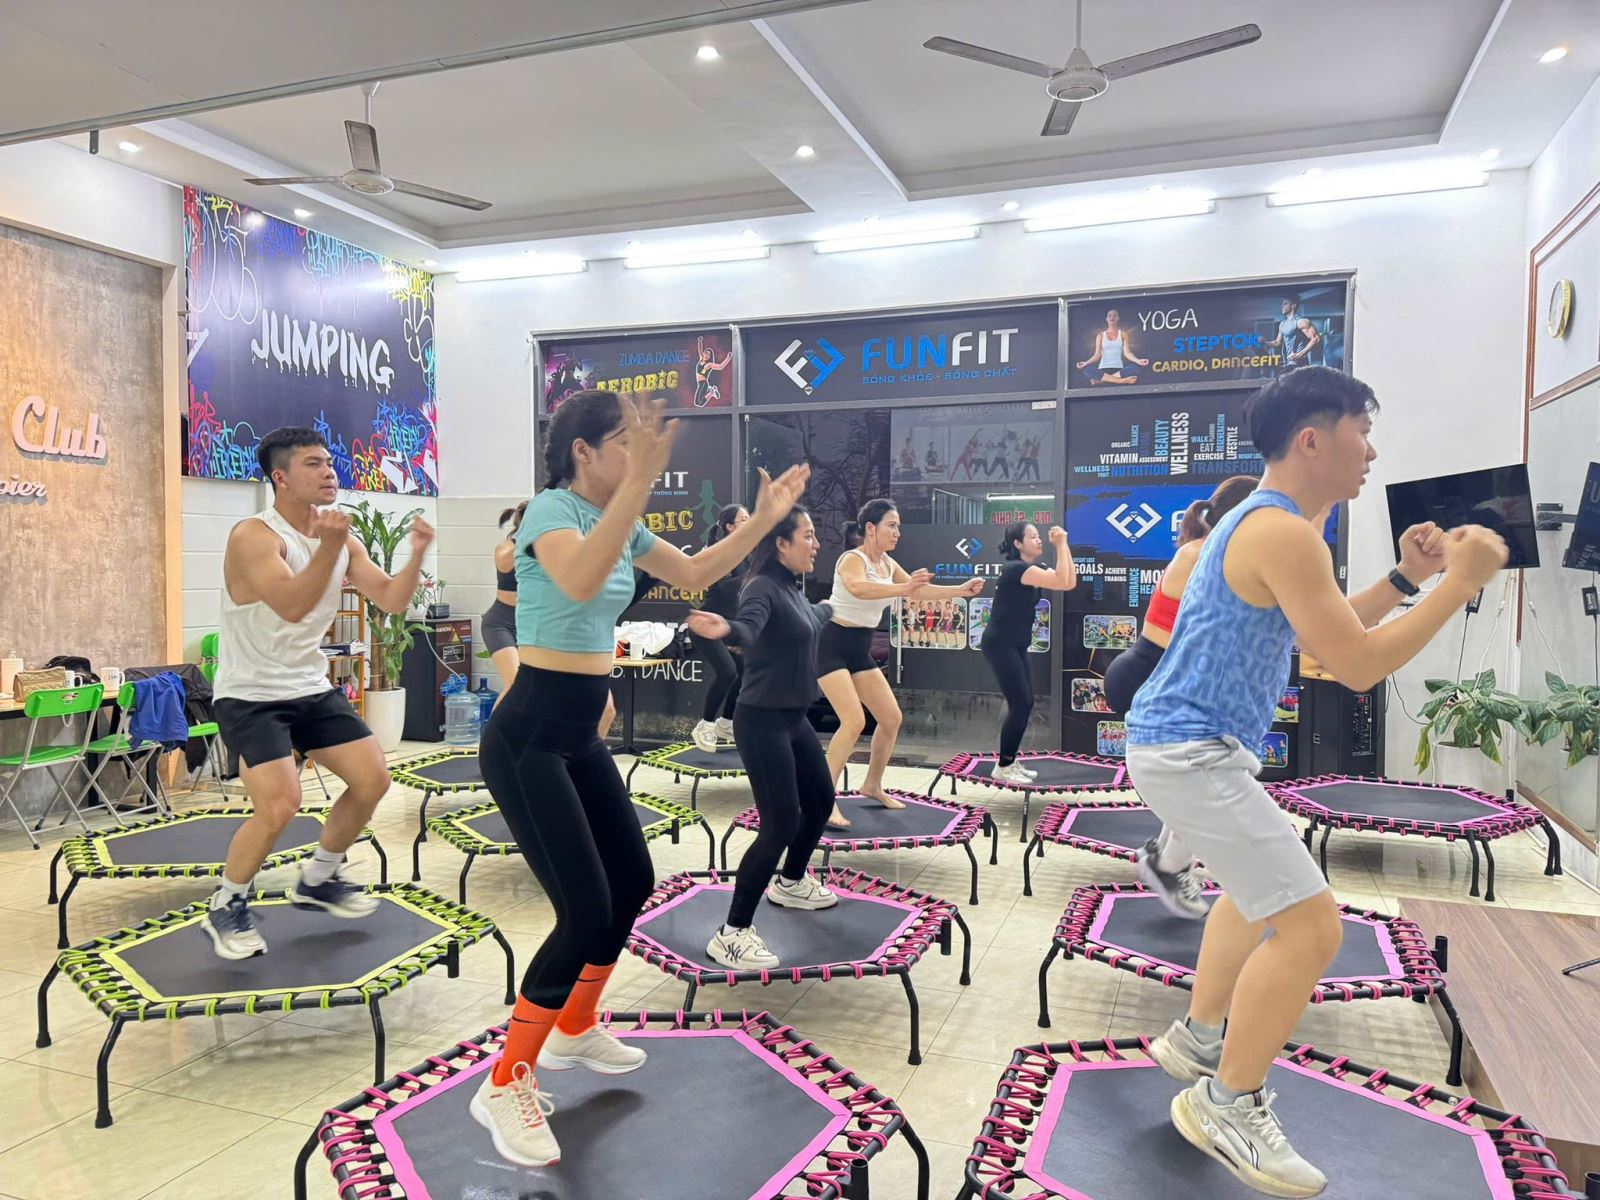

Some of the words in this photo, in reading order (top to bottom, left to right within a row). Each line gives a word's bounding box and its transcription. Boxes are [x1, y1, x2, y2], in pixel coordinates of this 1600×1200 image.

[1138, 308, 1198, 331] YOGA
[251, 308, 395, 393] JUMPING
[861, 328, 1019, 372] FUNFIT
[1152, 358, 1208, 373] CARDIO,
[1213, 354, 1281, 370] DANCEFIT
[12, 395, 107, 458] Club
[1155, 419, 1169, 456] BEAUTY
[1170, 412, 1189, 476] WELLNESS
[1191, 435, 1208, 443] WALK
[1226, 426, 1238, 460] LIFESTYLE
[1200, 443, 1215, 452] EAT
[1100, 453, 1138, 464] VITAMIN
[1194, 452, 1224, 461] EXERCISE
[1074, 465, 1110, 473] WELLNESS
[1111, 464, 1168, 477] NUTRITION
[650, 472, 689, 488] FIT
[935, 563, 1004, 576] FUNFIT
[1074, 563, 1104, 574] GOALS
[1129, 567, 1140, 607] ENDURANCE
[1139, 584, 1155, 595] HEA
